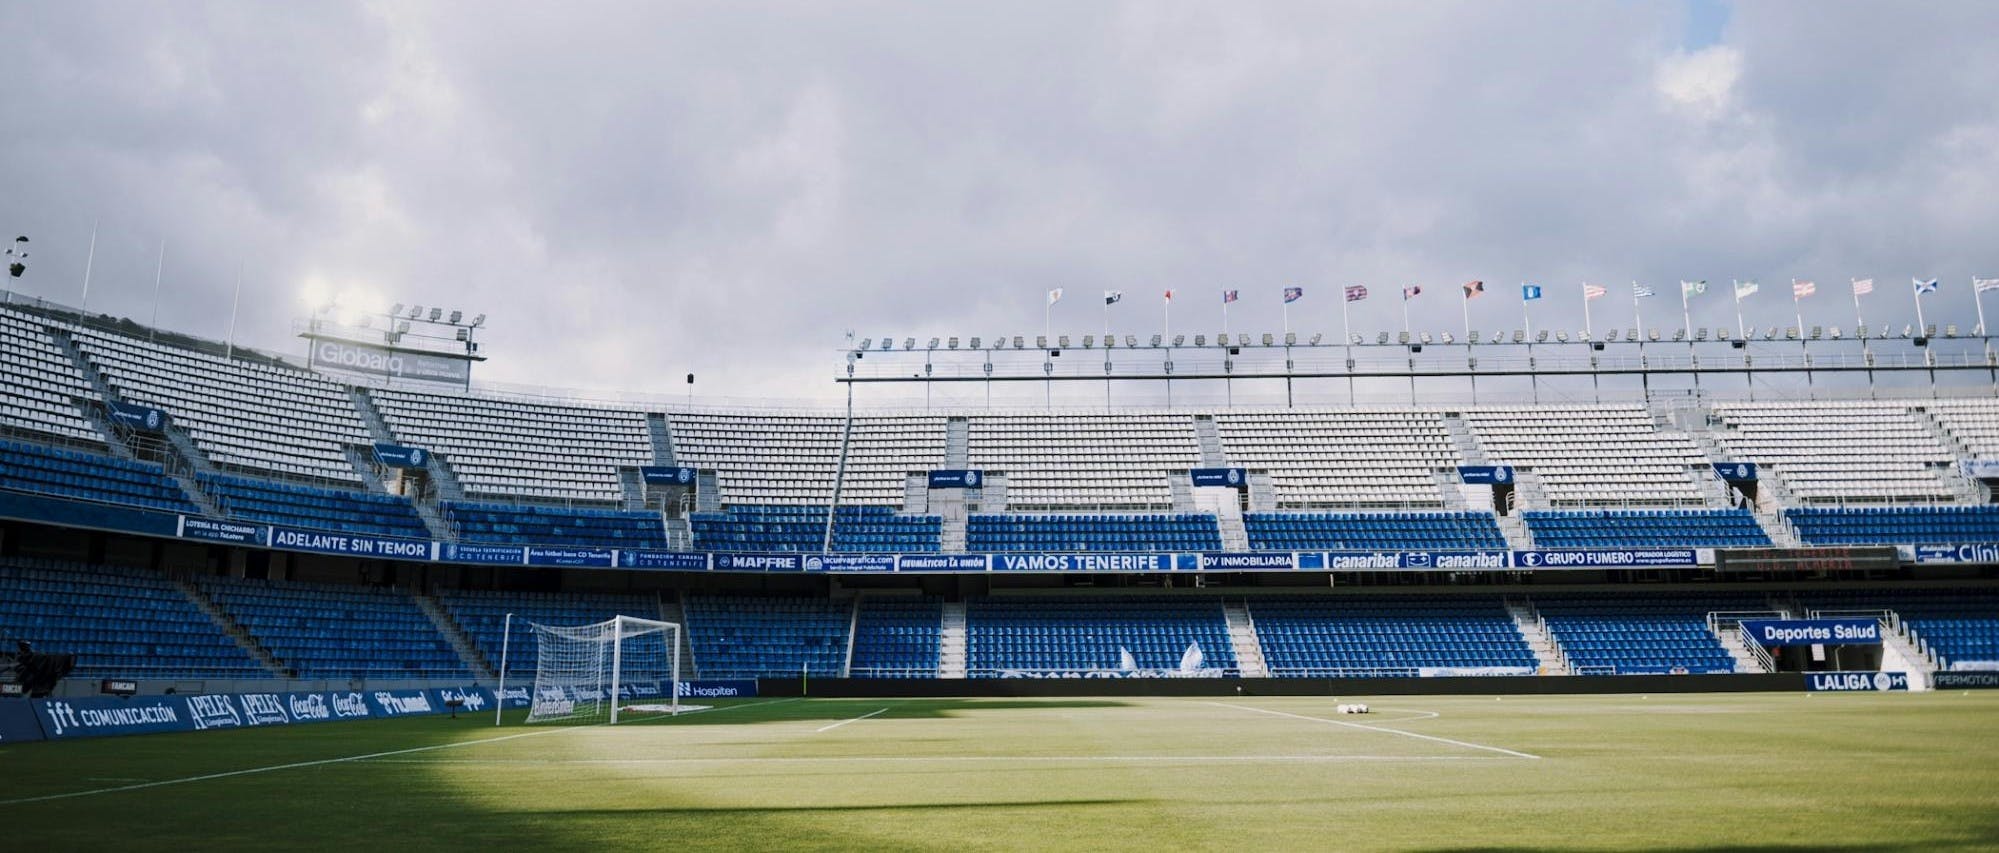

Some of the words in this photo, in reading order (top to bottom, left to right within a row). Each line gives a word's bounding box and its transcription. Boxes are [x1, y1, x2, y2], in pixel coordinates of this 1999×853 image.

[319, 341, 404, 376] Globarq
[212, 523, 219, 531] EL
[220, 524, 255, 534] CHICHARRO
[277, 531, 347, 550] ADELANTE
[351, 538, 373, 553] SIN
[377, 541, 425, 557] TEMOR
[657, 560, 703, 568] TENERIFE
[733, 556, 796, 568] MAPFRE
[901, 557, 948, 568] NEUMÁTICOS
[948, 558, 958, 567] LA
[960, 557, 984, 567] UNIÓN
[1004, 555, 1069, 570] VAMOS
[1074, 555, 1159, 570] TENERIFE
[1203, 556, 1218, 566] DV
[1220, 556, 1293, 567] INMOBILIARIA
[1332, 552, 1401, 569] canaribat
[1436, 552, 1504, 569] canaribat
[1545, 552, 1583, 565] GRUPO
[1587, 552, 1634, 564] FUMERO
[1764, 626, 1831, 643] Deportes
[1834, 624, 1876, 638] Salud
[1814, 675, 1871, 690] LALIGA
[693, 686, 738, 698] Hospiten
[186, 694, 240, 730] APELES
[240, 693, 289, 725] APELES
[46, 701, 79, 735] jft
[81, 702, 178, 727] COMUNICACIÓN
